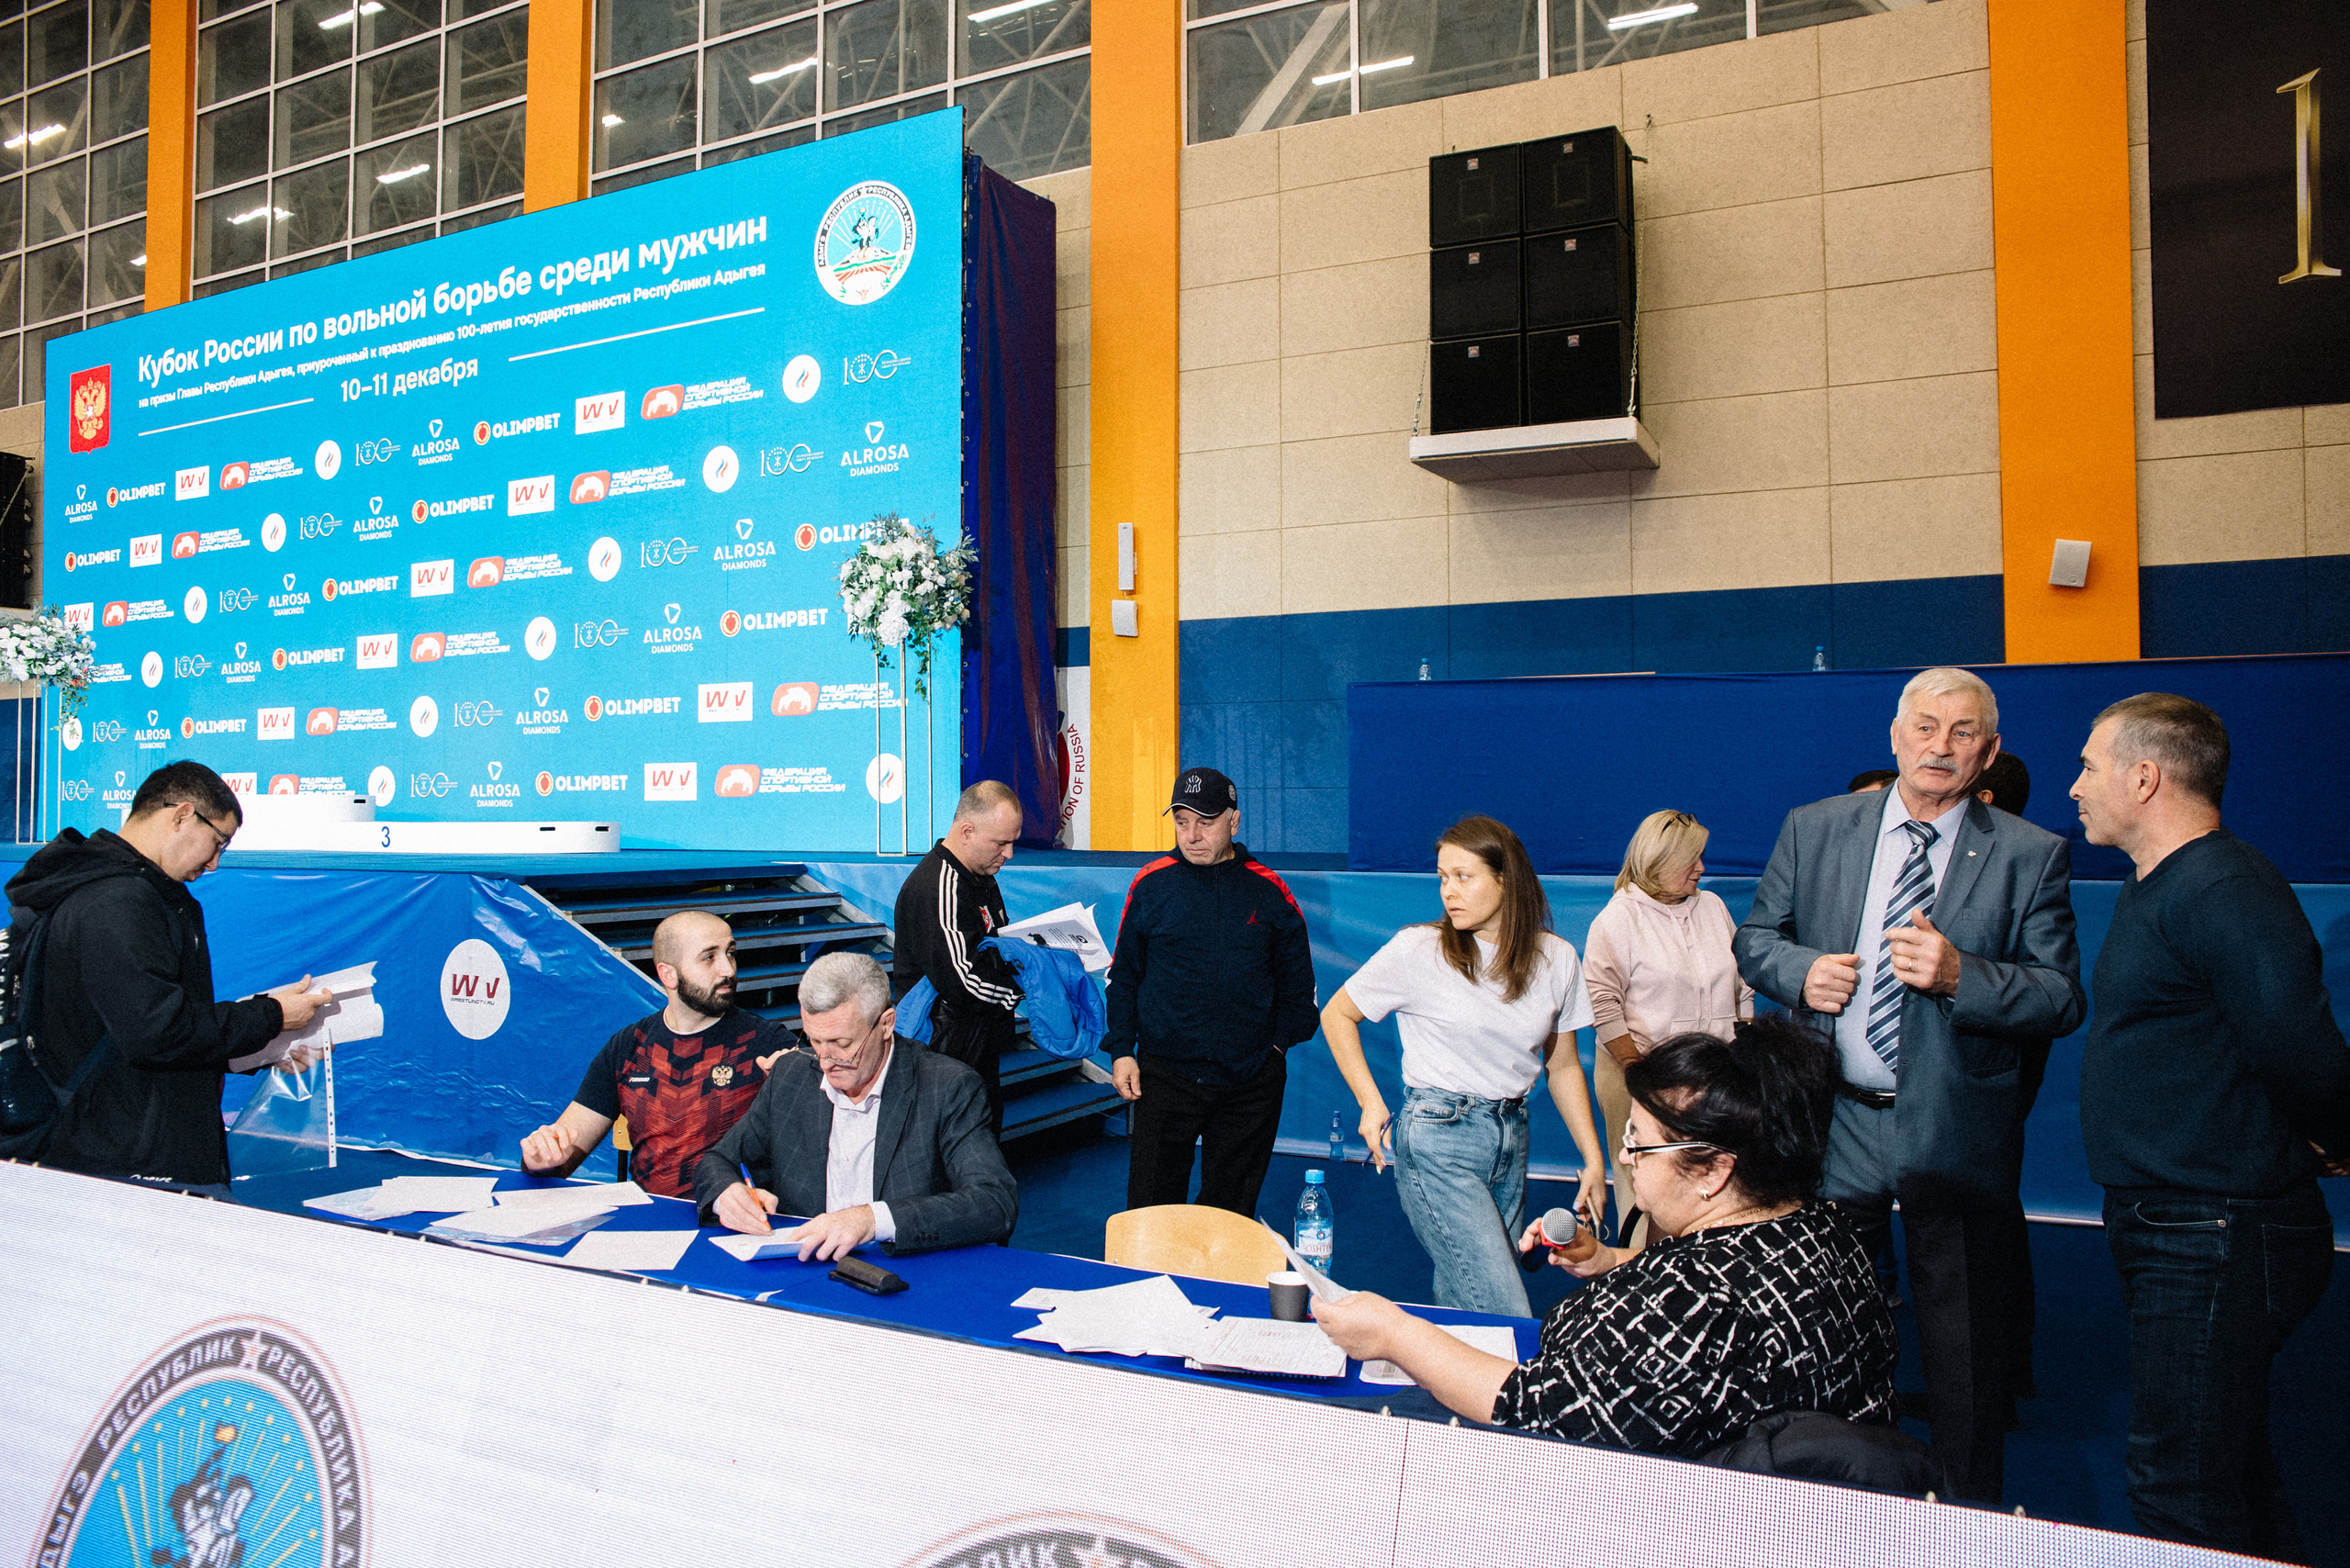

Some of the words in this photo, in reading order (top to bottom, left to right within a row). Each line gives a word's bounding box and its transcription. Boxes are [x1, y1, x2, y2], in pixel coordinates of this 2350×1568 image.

[139, 348, 198, 387] Кубок
[205, 330, 283, 366] России
[290, 322, 317, 347] по
[324, 288, 426, 340] вольной
[433, 266, 532, 316] борьбе
[540, 248, 629, 296] среди
[639, 216, 767, 274] мужчин
[139, 398, 148, 408] на
[150, 392, 175, 407] призы
[177, 386, 202, 399] Главы
[204, 375, 256, 393] Республики
[258, 366, 295, 383] Адыгея,
[297, 347, 368, 375] приуроченный
[371, 348, 376, 358] к
[378, 331, 454, 358] празднованию
[457, 319, 512, 339] 100-летия
[515, 293, 631, 327] государственности
[633, 275, 711, 301] Республики
[713, 263, 765, 285] Адыгея
[393, 358, 477, 397] декабря
[722, 389, 764, 403] РОССИИ
[492, 413, 560, 438] OLIMPBET
[412, 438, 459, 457] ALROSA
[841, 443, 909, 466] ALROSA
[419, 454, 453, 465] DIAMONDS
[850, 463, 899, 476] DIAMONDS
[119, 483, 165, 501] OLIMPBET
[647, 478, 686, 490] РОССИИ
[65, 501, 97, 515] ALROSA
[430, 495, 494, 517] OLIMPBET
[353, 515, 398, 532] ALROSA
[820, 518, 909, 543] OLIMP
[360, 531, 392, 541] DIAMONDS
[76, 549, 120, 566] OLIMPBET
[713, 541, 776, 561] ALROSA
[537, 566, 573, 577] РОССИИ
[722, 558, 767, 571] DIAMONDS
[339, 576, 398, 595] OLIMPBET
[268, 592, 310, 608] ALROSA
[274, 607, 304, 616] DIAMONDS
[743, 608, 828, 631] OLIMPBET
[643, 626, 702, 644] ALROSA
[286, 648, 345, 665] OLIMPBET
[476, 644, 510, 654] РОССИИ
[652, 643, 693, 654] DIAMONDS
[221, 661, 261, 675] ALROSA
[605, 697, 681, 715] OLIMPBET
[516, 710, 568, 724] ALROSA
[135, 729, 171, 741] ALROSA
[194, 719, 247, 734] OLIMPBET
[522, 725, 561, 734] DIAMONDS
[1067, 723, 1085, 773] RUSSIA
[470, 784, 520, 797] ALROSA
[555, 775, 628, 791] OLIMPBET
[802, 782, 846, 792] РОССИИ
[1073, 777, 1085, 796] OF
[381, 826, 391, 848] 3
[97, 1336, 236, 1452] РЕСПУБЛИК
[266, 1346, 356, 1531] РЕСПУБЛИКА
